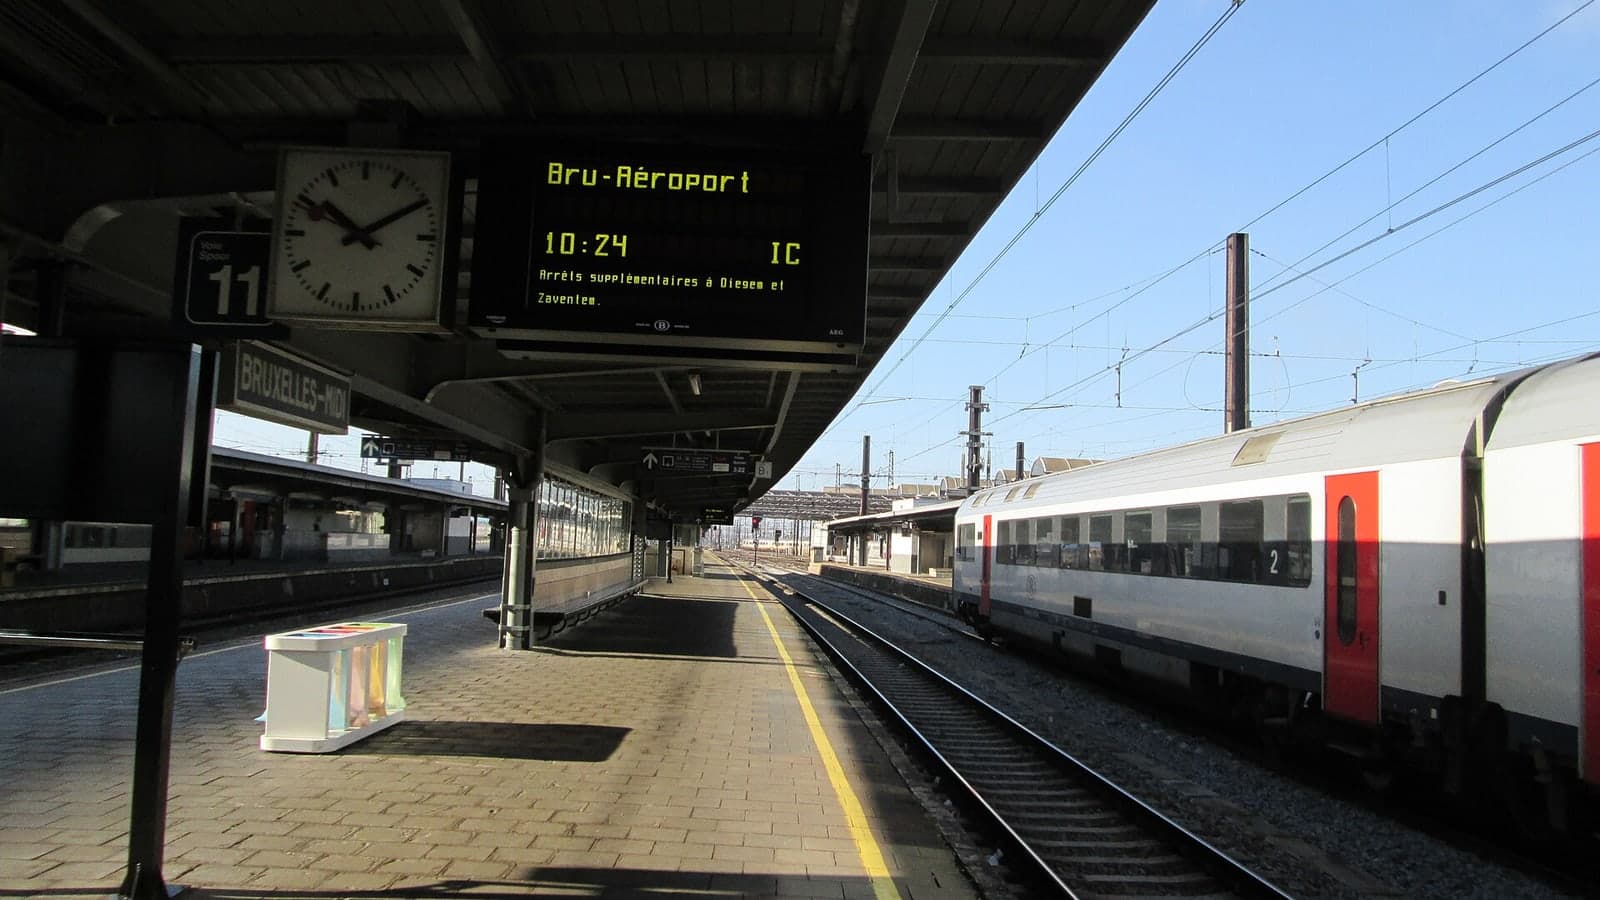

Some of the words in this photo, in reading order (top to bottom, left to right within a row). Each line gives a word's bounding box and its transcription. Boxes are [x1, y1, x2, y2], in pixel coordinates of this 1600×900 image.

[547, 162, 750, 194] Bru-Aéroport
[545, 231, 629, 257] 10:24
[771, 241, 801, 265] IC
[208, 264, 261, 316] 11
[719, 277, 763, 290] Diegem
[240, 352, 347, 423] BRUXELLES-MIDI
[1269, 549, 1279, 575] 2
